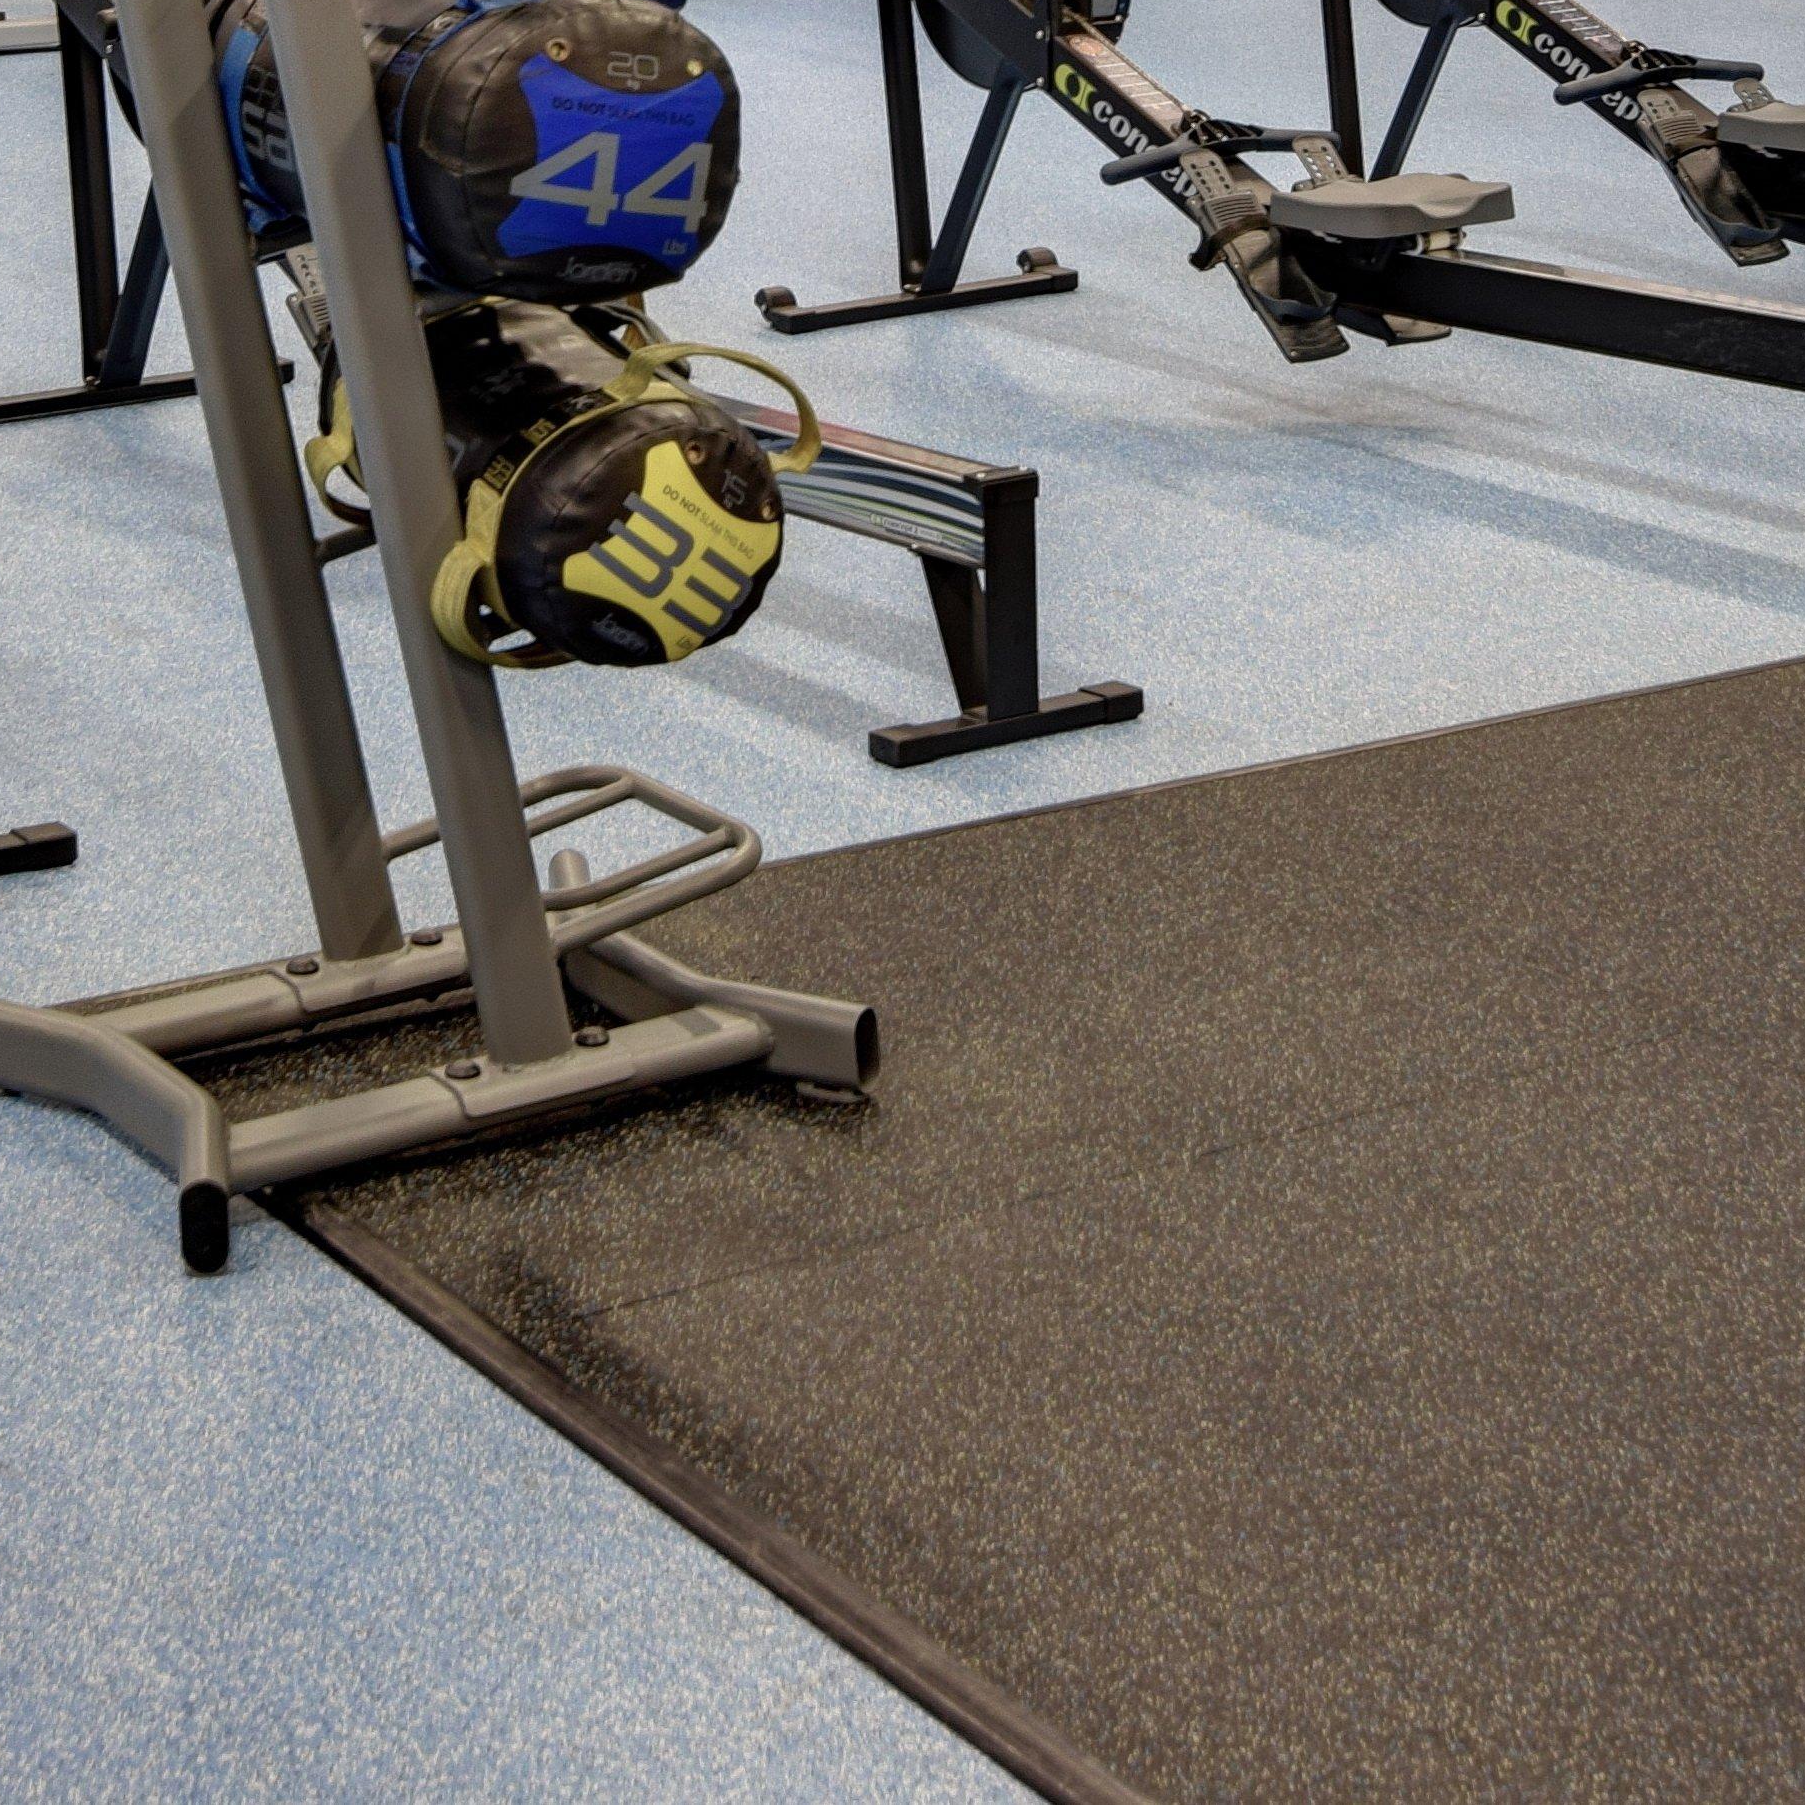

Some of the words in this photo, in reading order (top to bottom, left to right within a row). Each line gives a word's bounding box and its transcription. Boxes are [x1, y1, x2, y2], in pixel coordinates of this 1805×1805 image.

[606, 51, 659, 82] 20
[577, 101, 606, 115] NOT
[509, 130, 714, 234] 44
[721, 468, 748, 506] 15
[662, 484, 681, 501] DO
[679, 496, 701, 517] NOT
[698, 511, 724, 539] SLAM
[721, 528, 739, 548] THIS
[736, 541, 755, 560] BAG
[588, 491, 755, 638] 33
